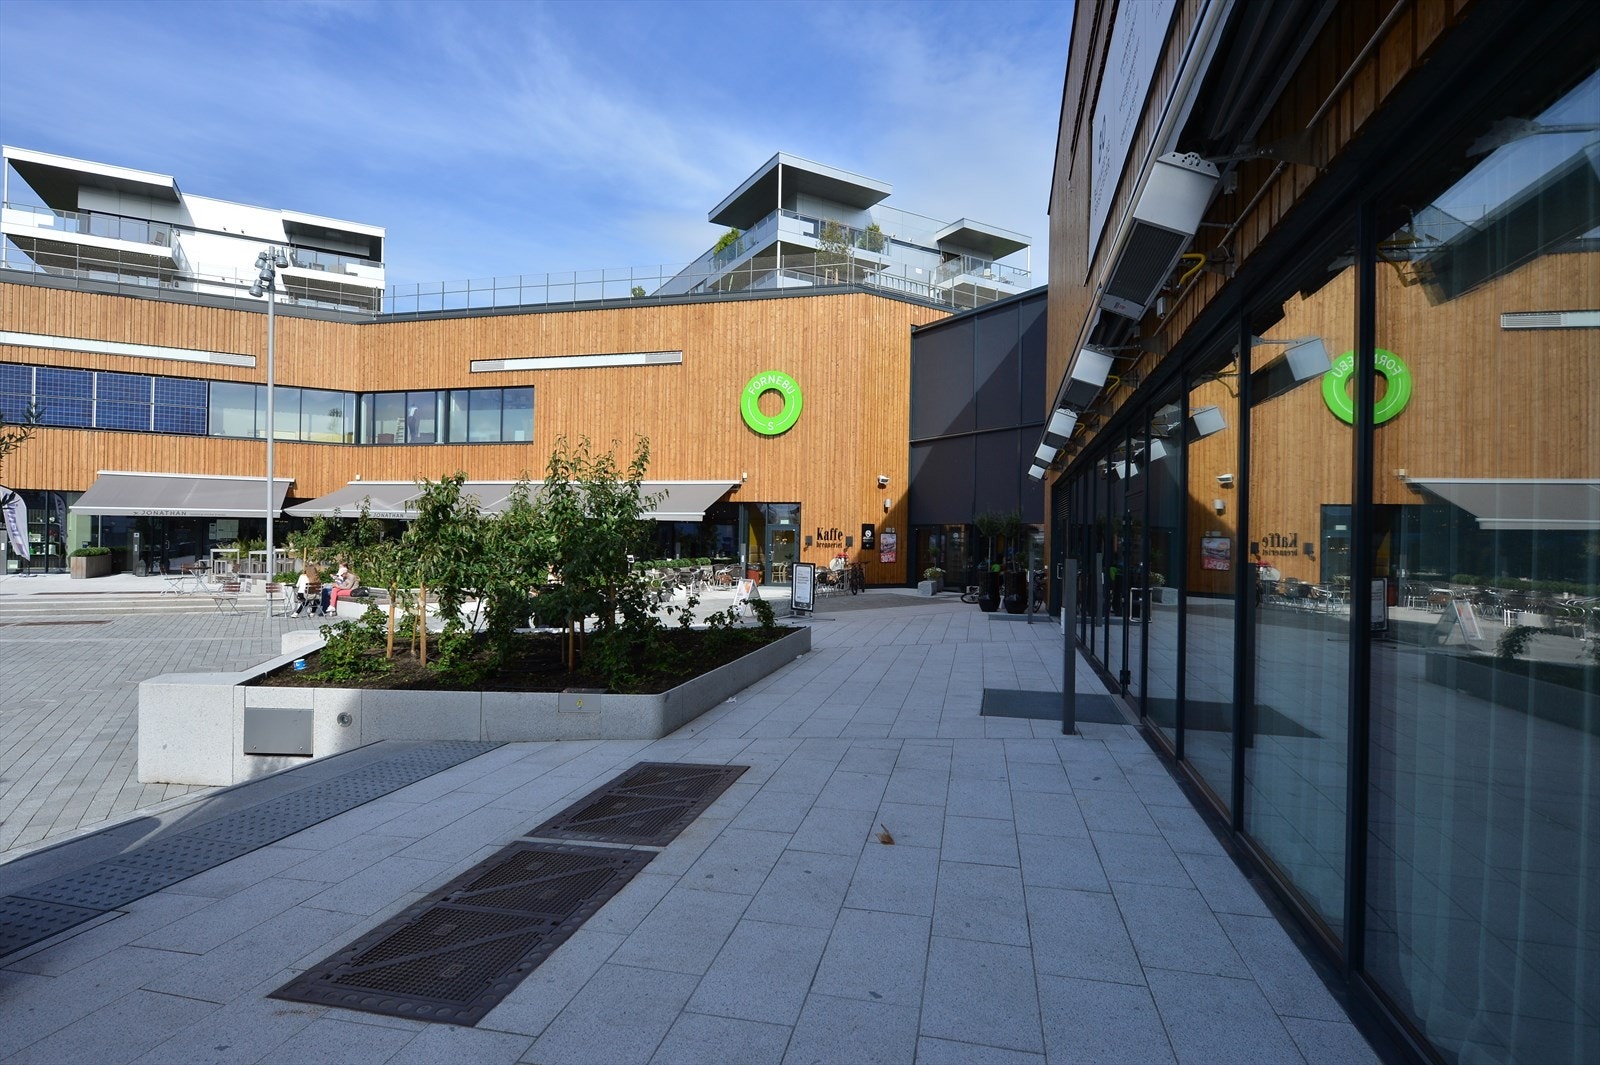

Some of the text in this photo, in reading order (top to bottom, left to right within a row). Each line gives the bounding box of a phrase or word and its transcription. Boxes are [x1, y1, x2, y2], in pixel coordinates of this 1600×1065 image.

[748, 375, 795, 395] FORNEBU
[768, 422, 774, 430] S
[816, 527, 843, 541] Kaffe
